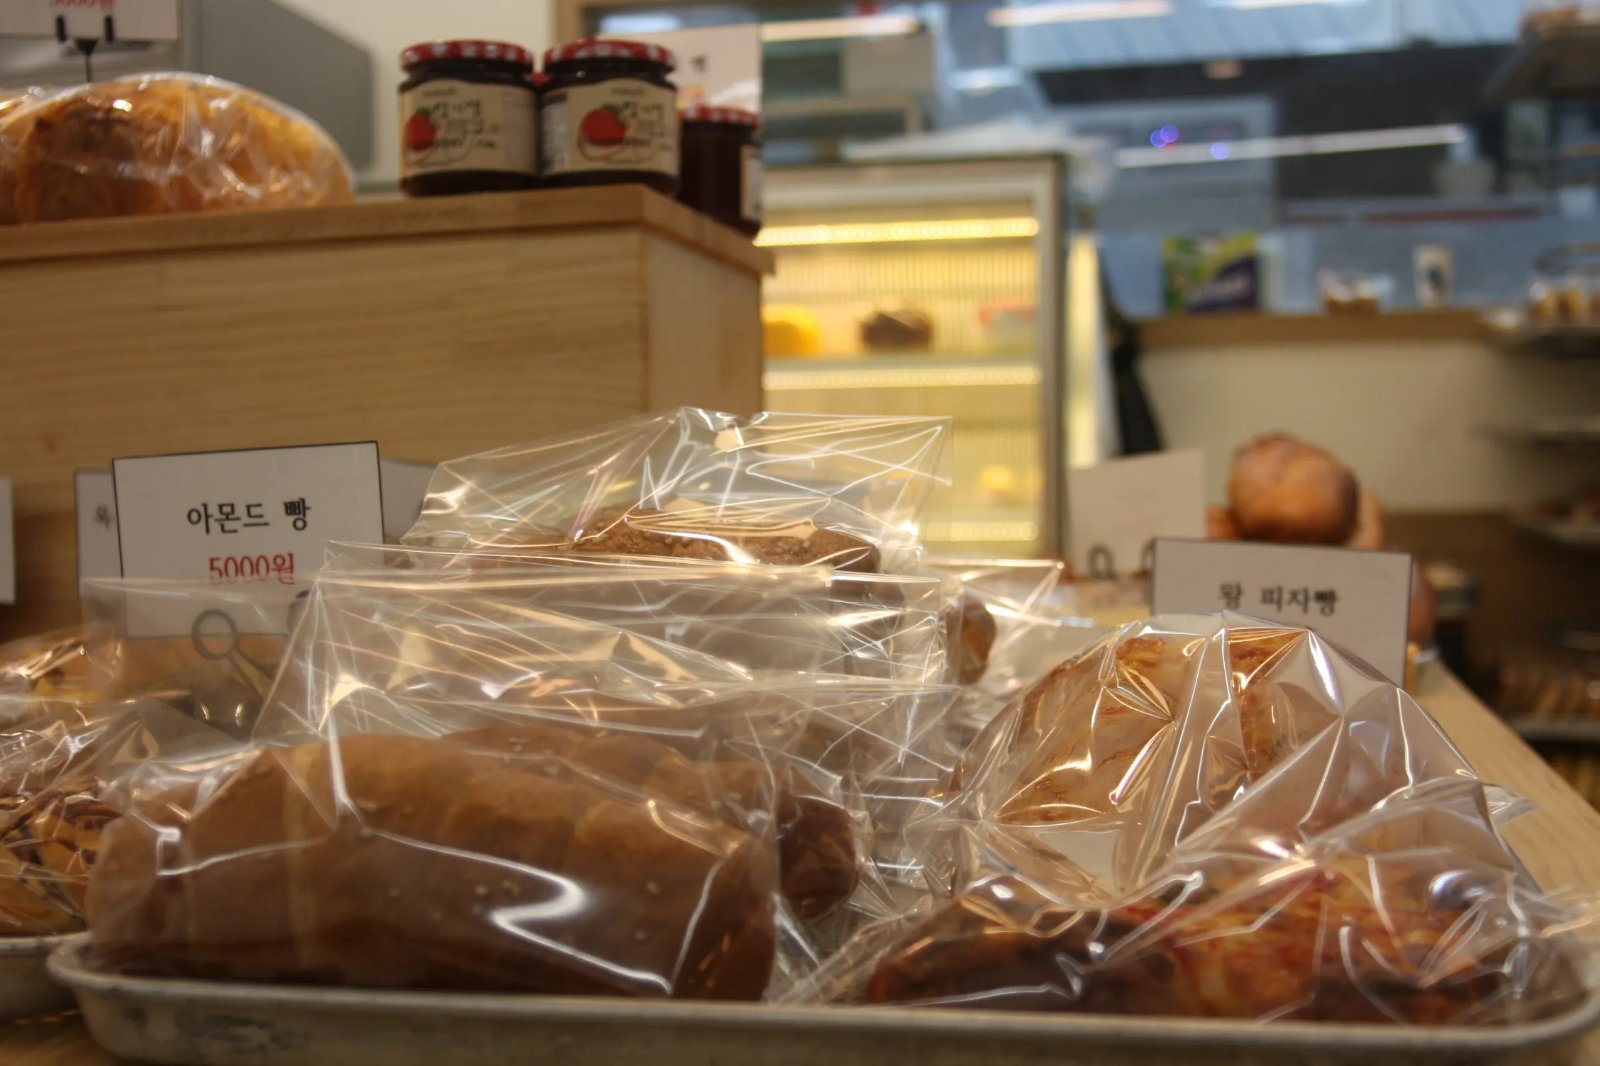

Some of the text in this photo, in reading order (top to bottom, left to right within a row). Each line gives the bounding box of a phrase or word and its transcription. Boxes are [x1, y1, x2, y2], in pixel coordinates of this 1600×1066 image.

[187, 498, 311, 535] 아몬드 빵
[208, 551, 296, 585] 5000원
[1261, 585, 1339, 617] 피자빵
